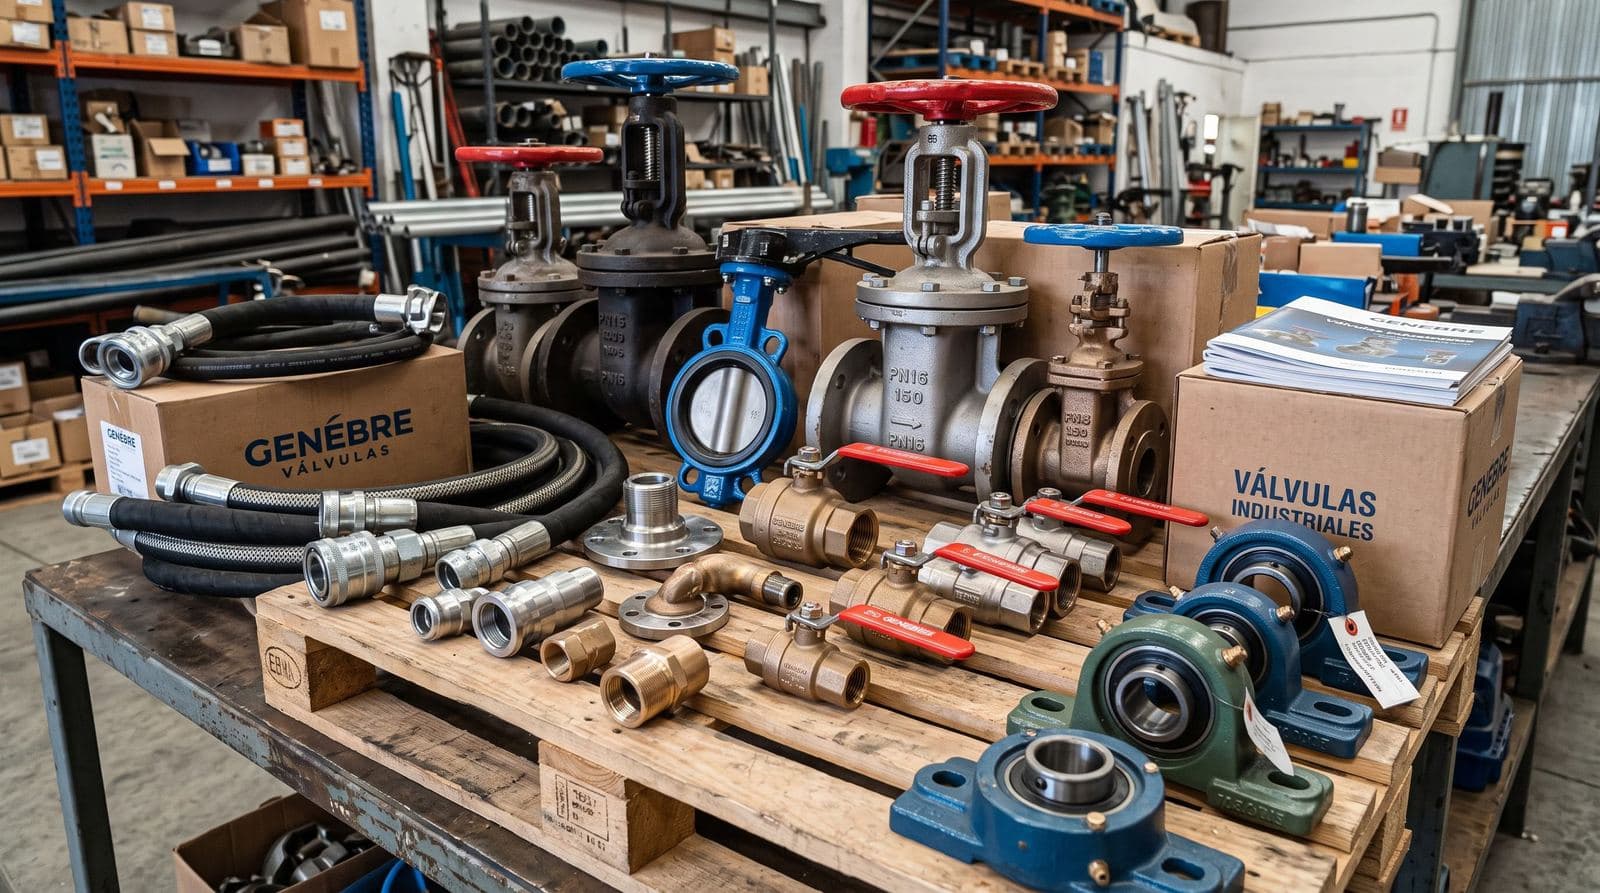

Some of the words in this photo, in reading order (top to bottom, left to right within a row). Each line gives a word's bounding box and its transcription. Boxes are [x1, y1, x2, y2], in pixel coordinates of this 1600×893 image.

[889, 367, 929, 386] PN16
[894, 388, 923, 405] 150
[244, 408, 414, 467] GENÉBRE
[888, 432, 925, 452] PN16
[282, 444, 390, 479] VÁLVULAS
[1234, 467, 1377, 518] VÁLVULAS
[1231, 499, 1375, 542] INDUSTRIALES
